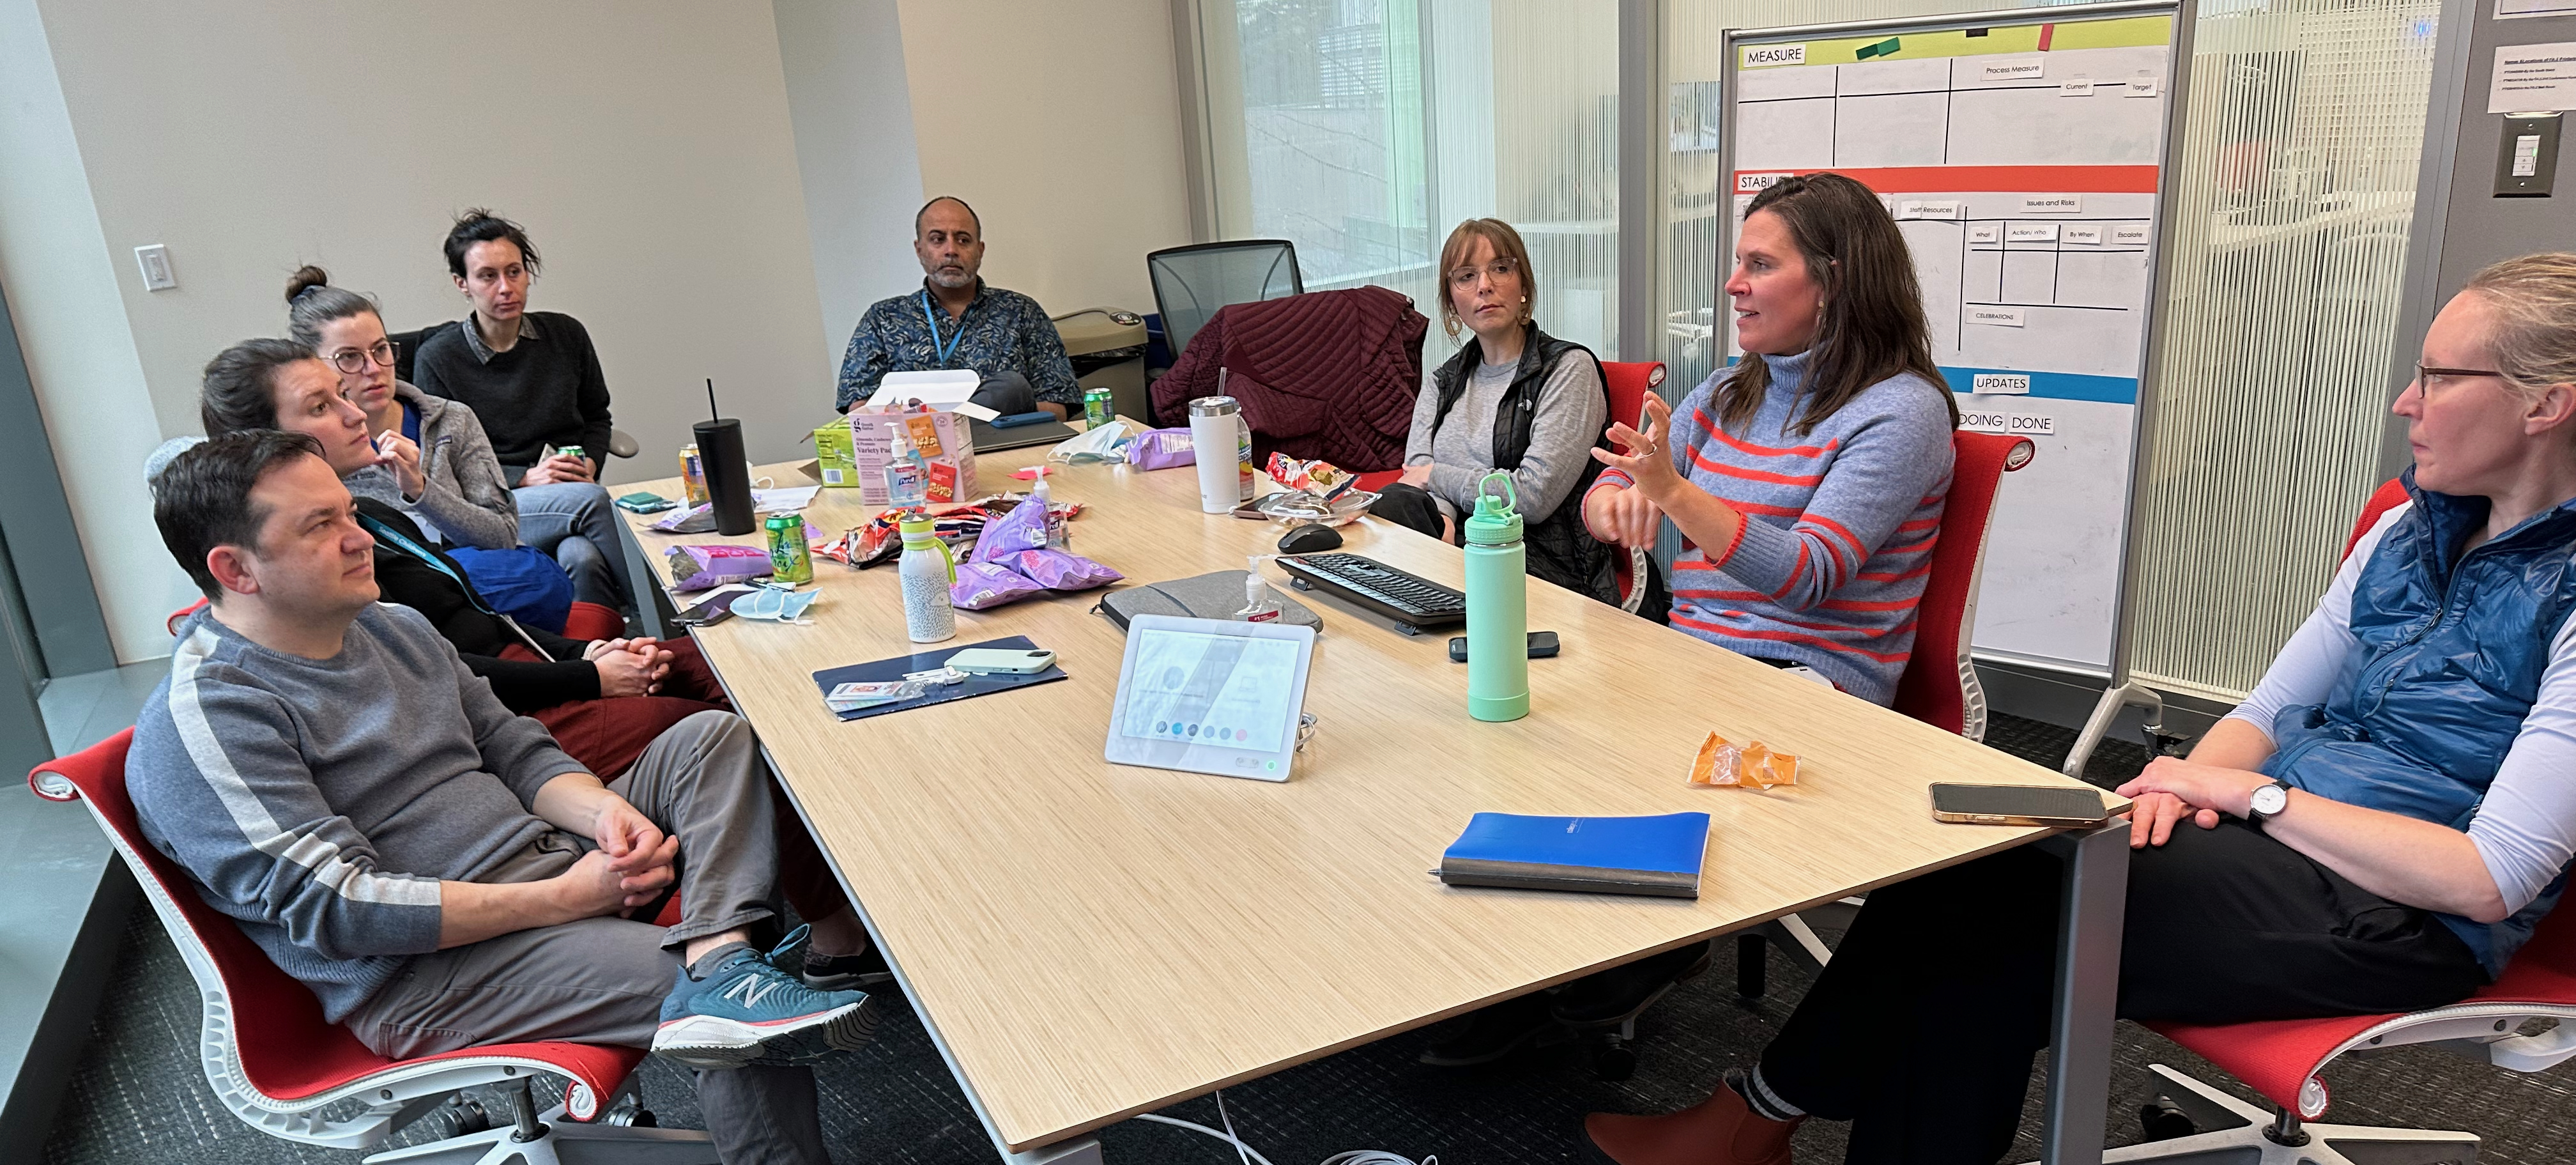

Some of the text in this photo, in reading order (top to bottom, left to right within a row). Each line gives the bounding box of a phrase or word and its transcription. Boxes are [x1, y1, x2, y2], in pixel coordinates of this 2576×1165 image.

[1748, 48, 1802, 63] MEASURE
[1977, 378, 2026, 389] UPDATES
[1959, 413, 2051, 429] DOING DONE
